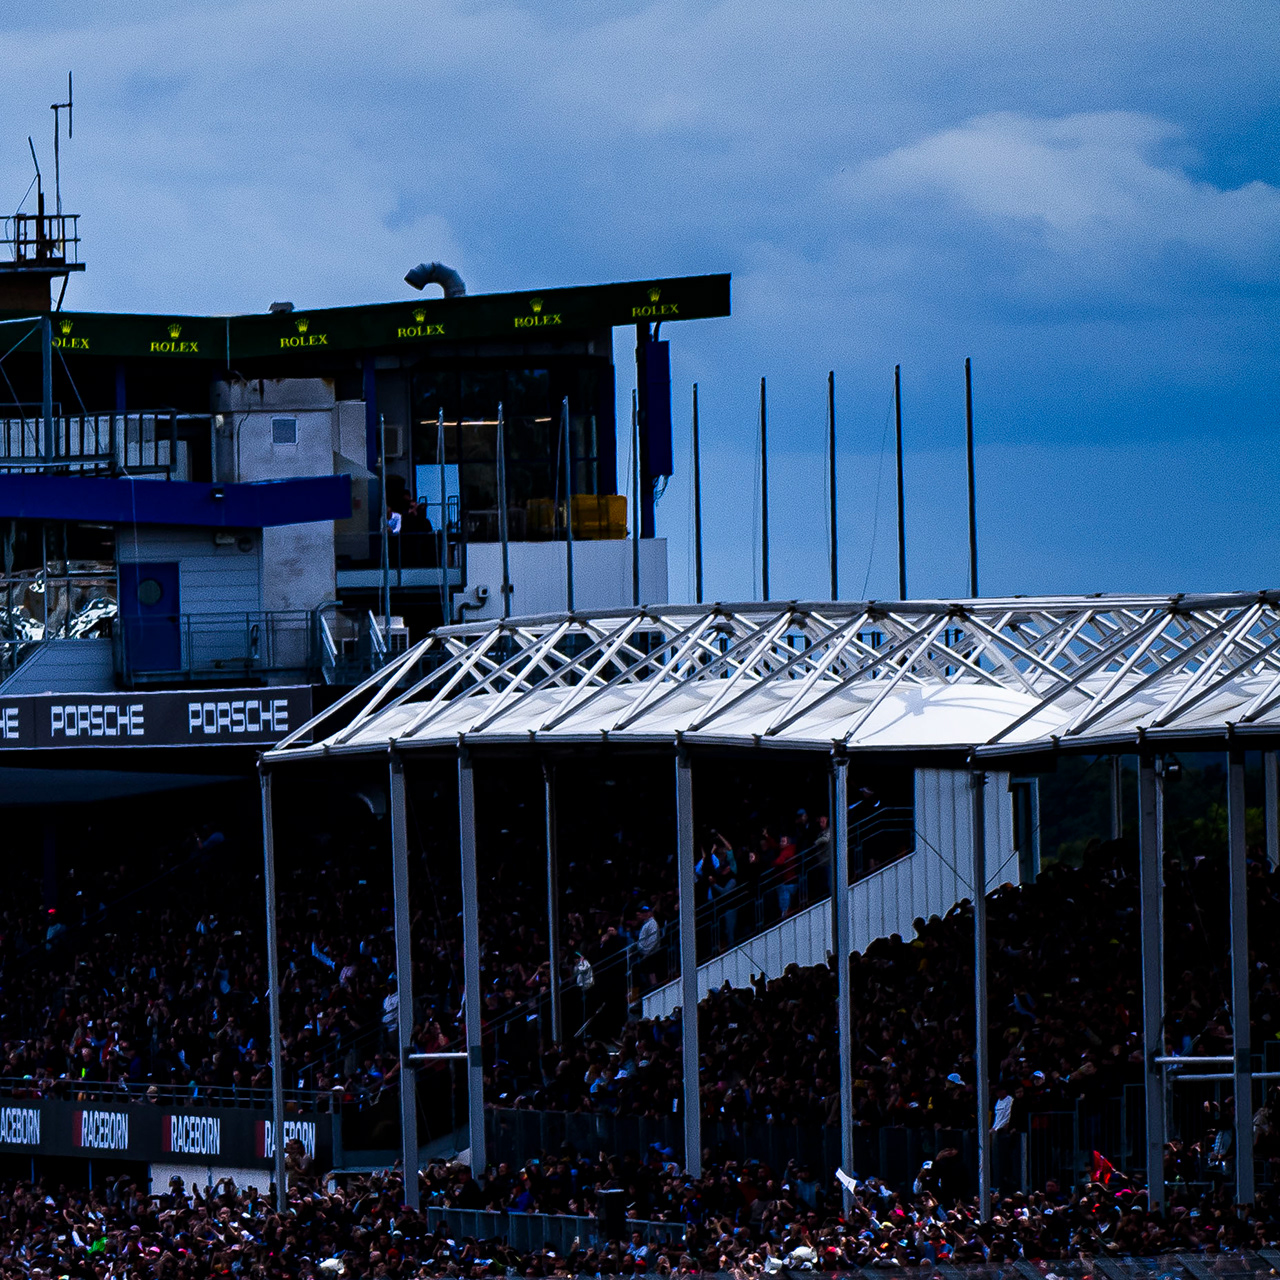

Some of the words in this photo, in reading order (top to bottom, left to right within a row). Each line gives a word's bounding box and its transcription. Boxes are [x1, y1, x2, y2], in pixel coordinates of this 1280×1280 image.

[632, 303, 679, 317] ROLEX
[514, 314, 562, 328] ROLEX
[397, 325, 445, 338] ROLEX
[51, 337, 90, 349] OLEX
[150, 341, 199, 353] ROLEX
[280, 333, 328, 348] ROLEX
[50, 704, 145, 737] PORSCHE
[188, 699, 289, 734] PORSCHE
[81, 1110, 129, 1150] RACEBORN
[170, 1115, 220, 1155] RACEBORN
[264, 1120, 316, 1160] RAEBORN
